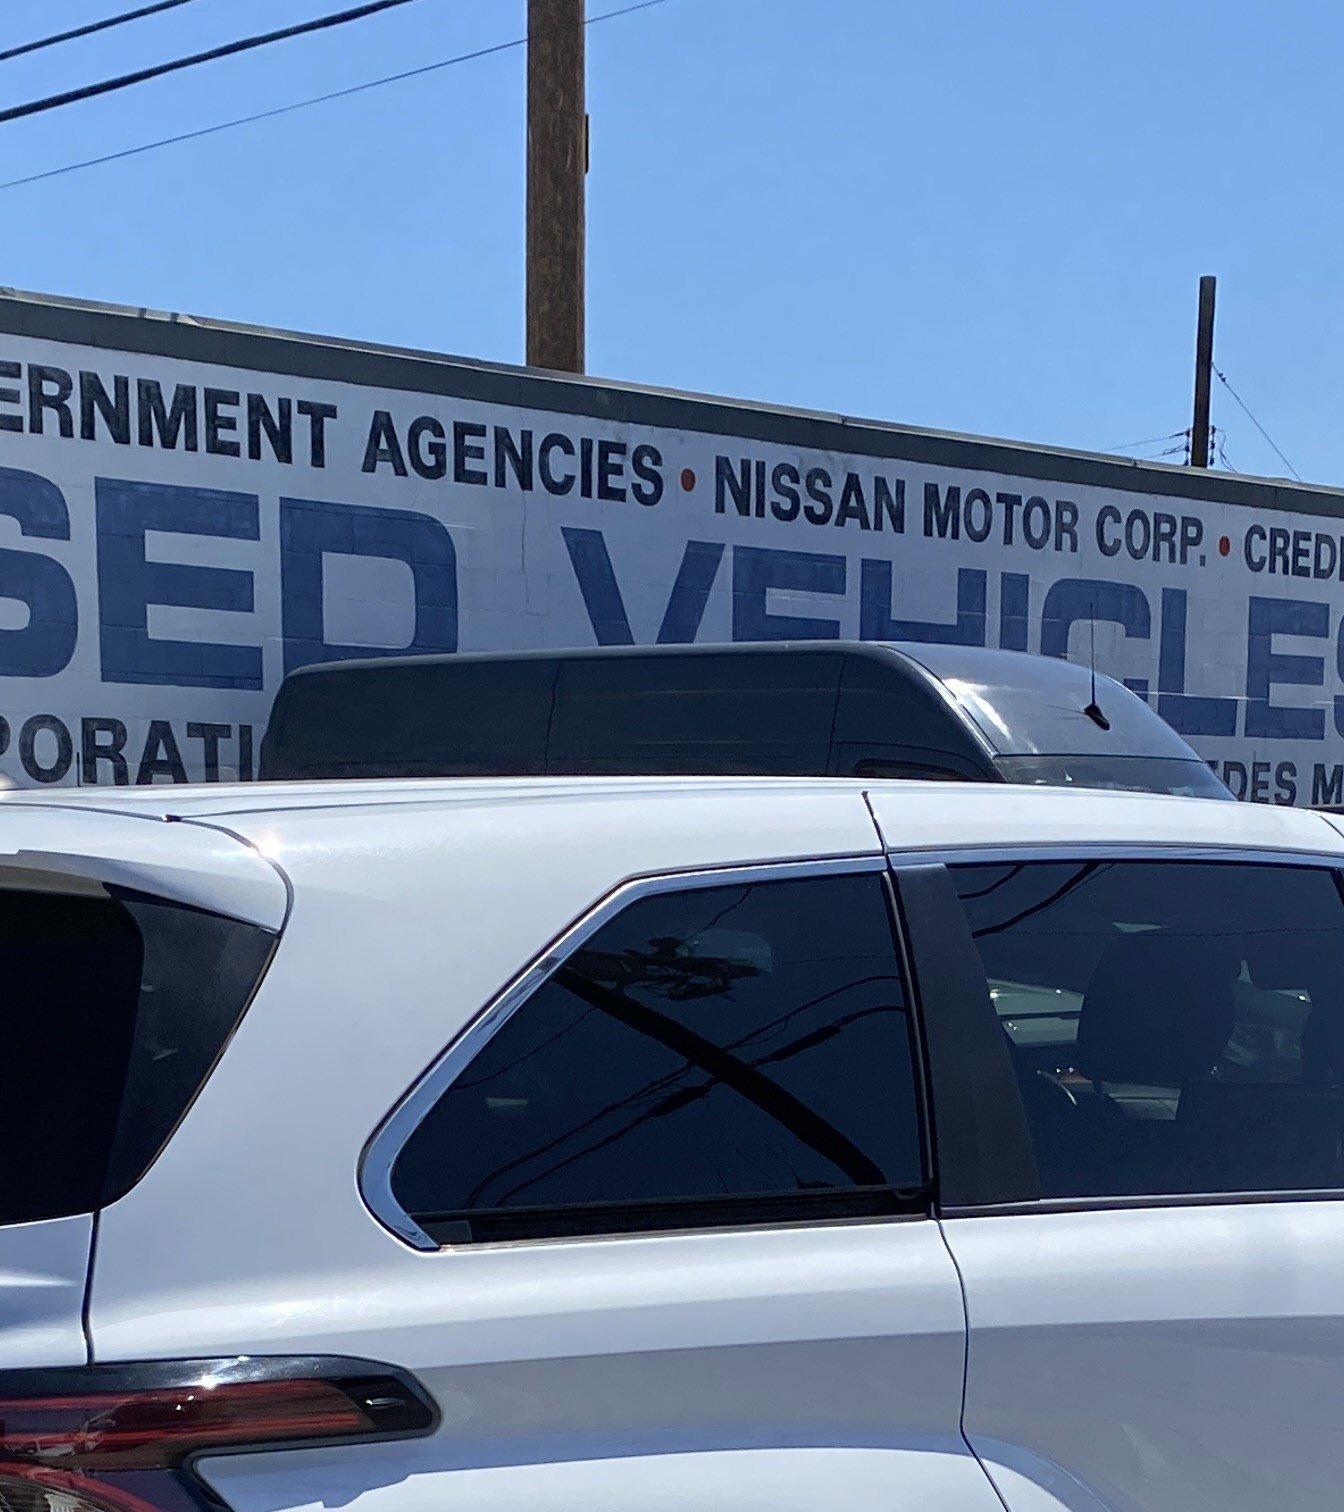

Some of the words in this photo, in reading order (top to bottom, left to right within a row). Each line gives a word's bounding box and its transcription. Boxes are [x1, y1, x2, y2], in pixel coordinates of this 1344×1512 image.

[362, 410, 664, 506] AGENCIES
[715, 456, 905, 535] NISSAN
[924, 482, 1077, 552] MOTOR
[1095, 505, 1205, 566] CORP.
